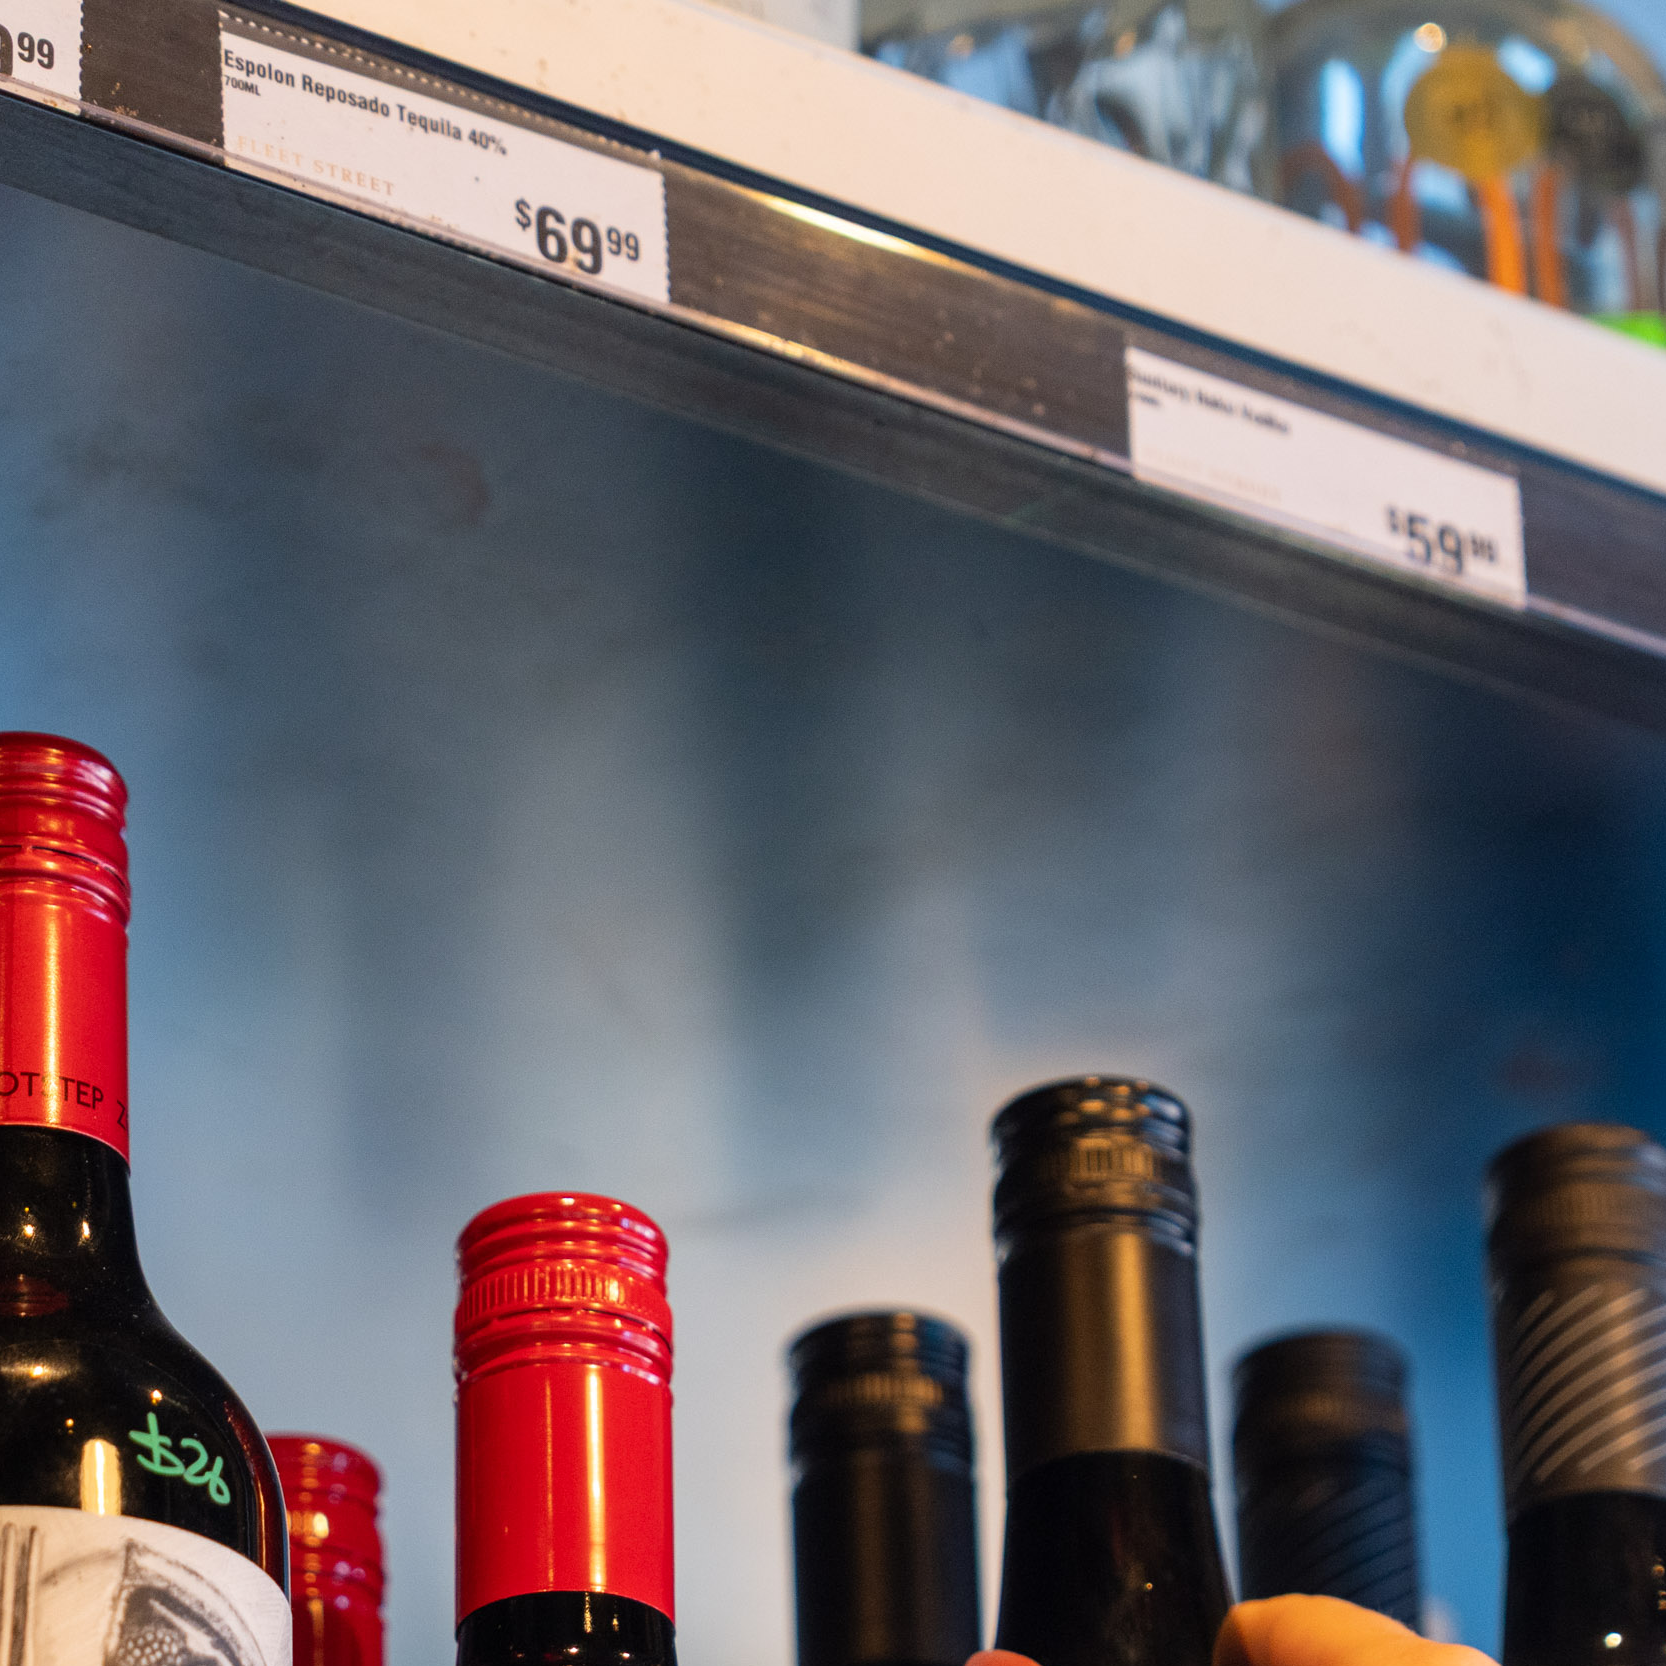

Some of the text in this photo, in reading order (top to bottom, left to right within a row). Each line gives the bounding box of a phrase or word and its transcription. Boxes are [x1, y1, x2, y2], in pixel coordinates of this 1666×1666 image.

[224, 75, 261, 97] 700ML
[224, 49, 507, 156] Espolon Reposado Tequila 40%
[237, 135, 396, 197] FLEET STREET
[129, 1411, 231, 1506] $26
